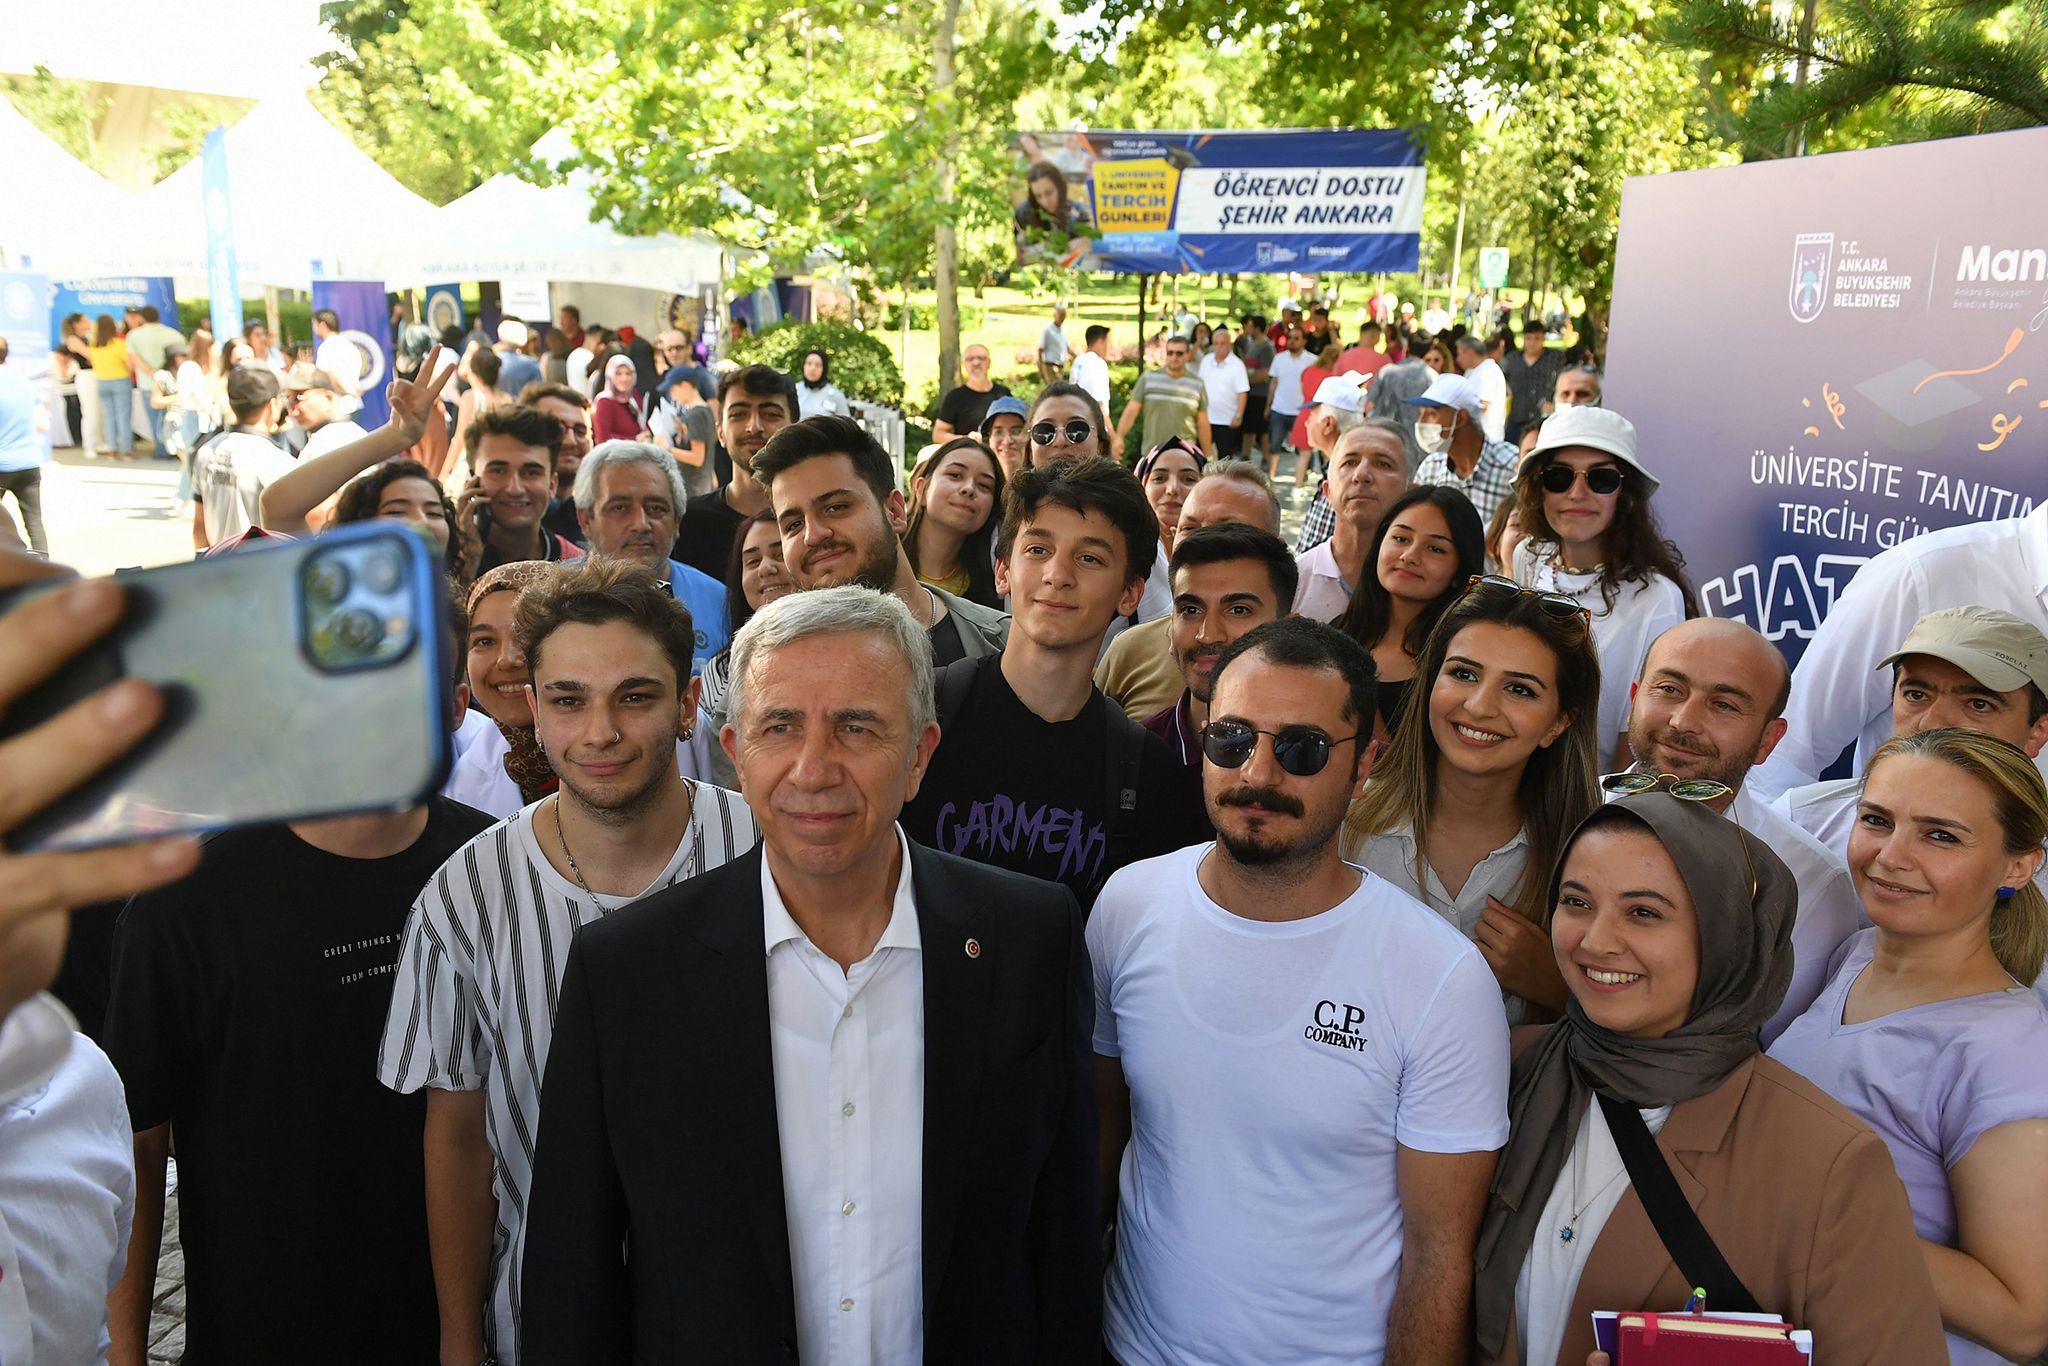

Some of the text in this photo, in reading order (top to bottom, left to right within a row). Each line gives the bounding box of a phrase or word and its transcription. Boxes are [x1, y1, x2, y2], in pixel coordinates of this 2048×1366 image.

[1214, 169, 1404, 196] ÖĞRENCİ DOSTU
[1218, 198, 1394, 231] ŞEHİR ANKARA
[1840, 241, 1860, 254] T.C.
[1837, 258, 1888, 272] ANKARA
[1750, 445, 1903, 498] ÜNİVERSİTE
[1778, 500, 1869, 544] TERCİH
[324, 943, 352, 958] GREAT
[357, 935, 391, 950] THINGS
[341, 971, 364, 985] FROM
[1314, 1000, 1365, 1035] C.P.
[1304, 1025, 1368, 1052] COMPANY
